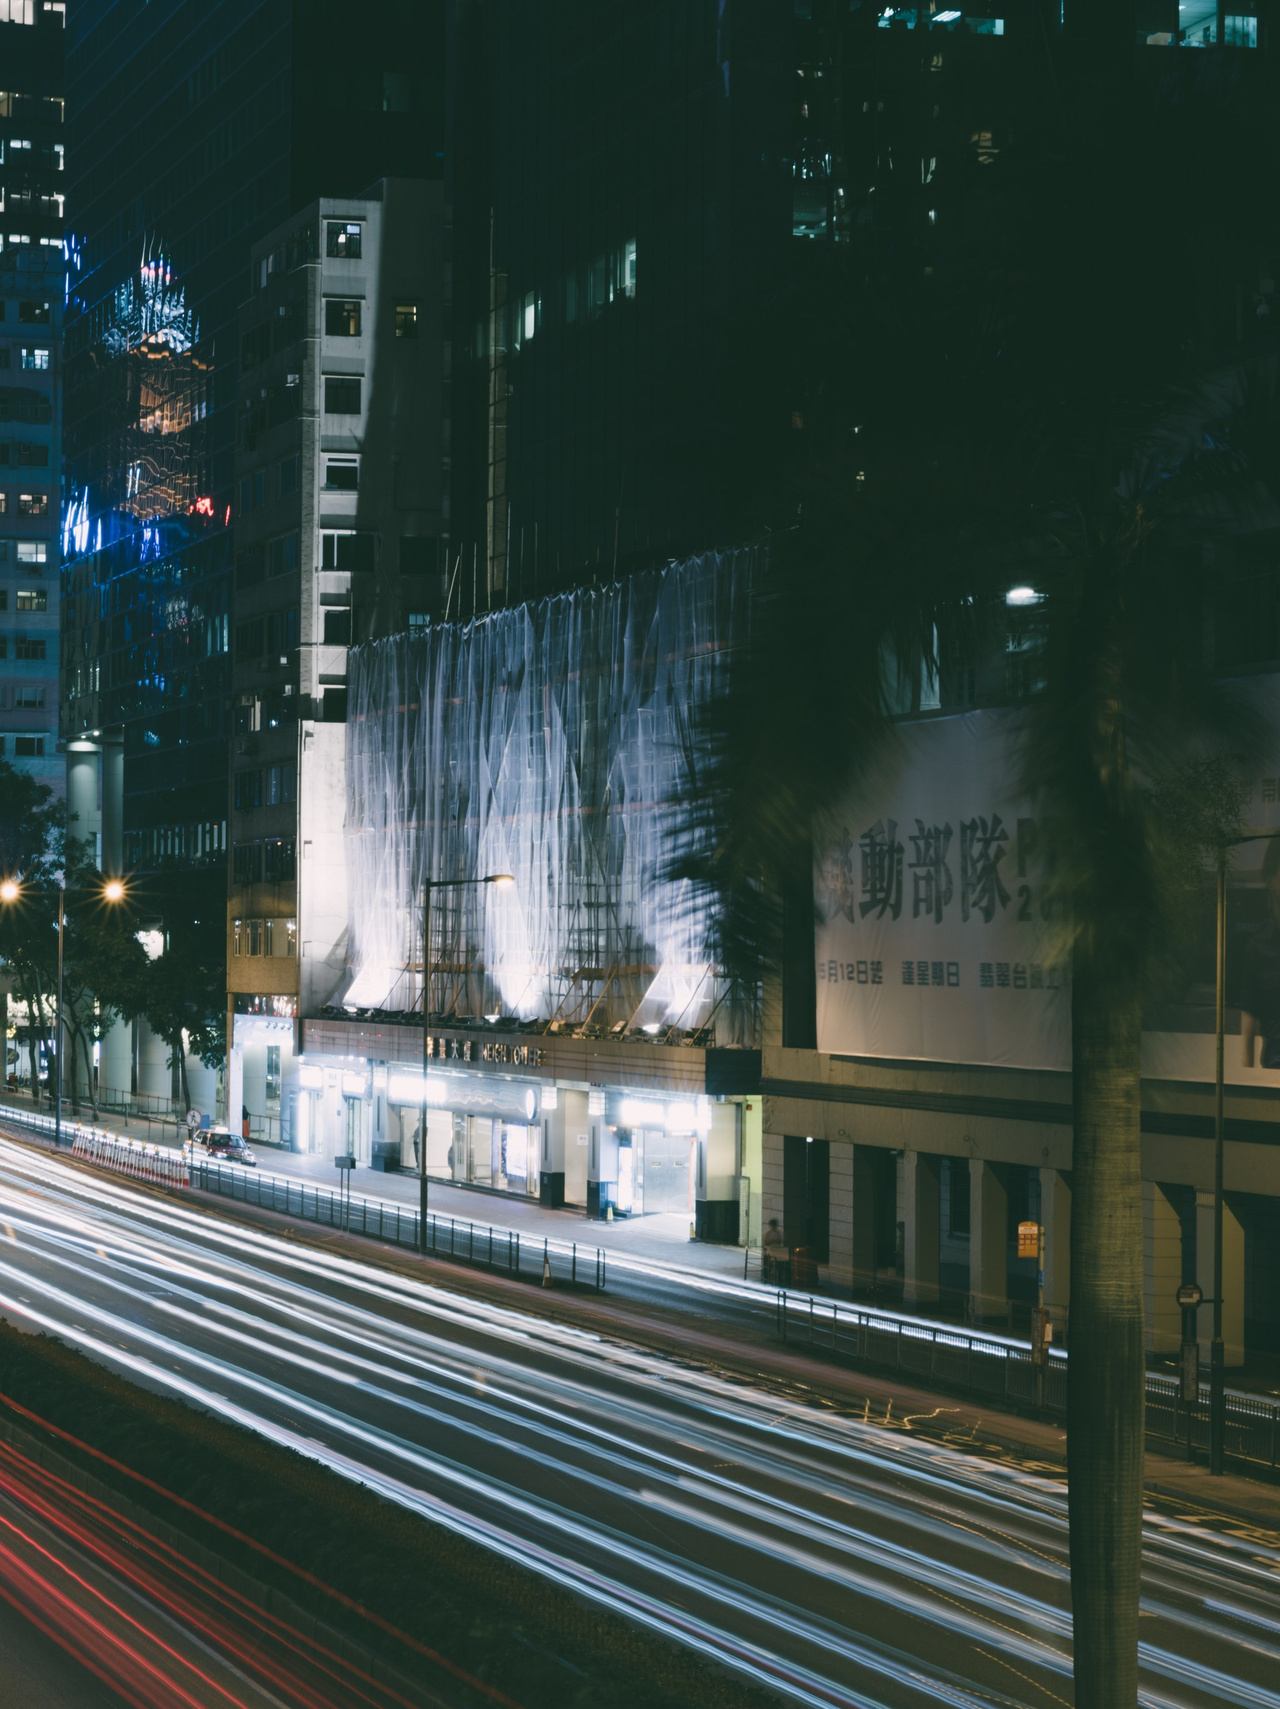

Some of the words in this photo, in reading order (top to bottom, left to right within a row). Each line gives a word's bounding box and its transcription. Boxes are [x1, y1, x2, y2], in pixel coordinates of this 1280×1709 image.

[901, 960, 961, 987] 逢星期日
[510, 1045, 541, 1067] TOWER
